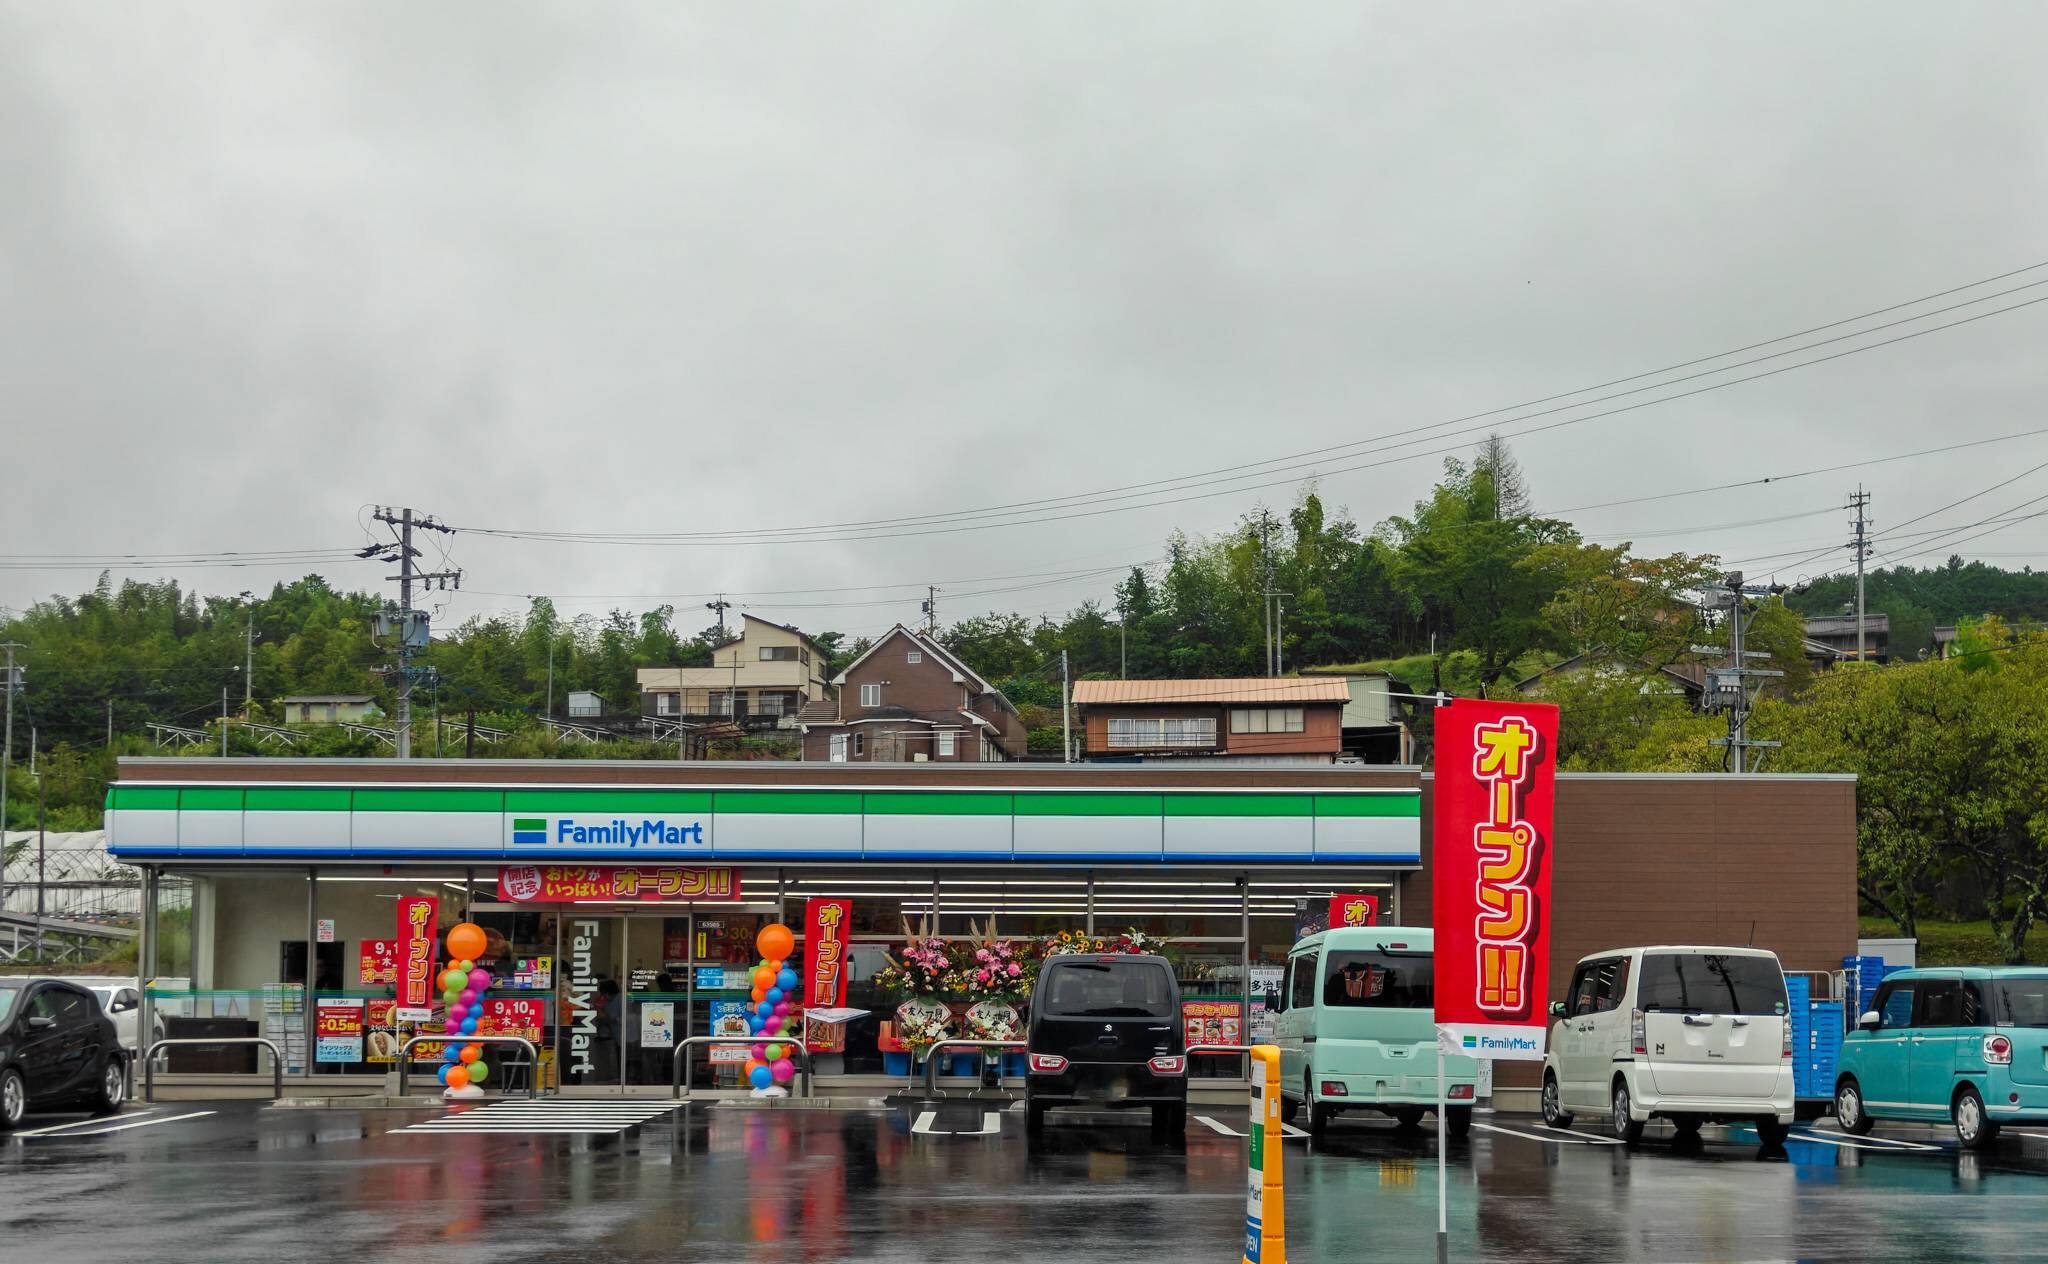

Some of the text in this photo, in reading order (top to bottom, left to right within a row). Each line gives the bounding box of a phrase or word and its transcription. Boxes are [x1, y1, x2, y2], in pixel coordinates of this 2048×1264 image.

[558, 819, 702, 847] FamilyMart
[1473, 716, 1537, 1010] オープン!!
[507, 867, 535, 881] 開店
[546, 867, 601, 882] おトクが
[613, 867, 731, 896] オープン!!
[510, 881, 539, 895] 記念
[546, 882, 610, 897] いっぱい!
[408, 901, 431, 1004] オープン!!
[568, 920, 599, 1074] FamilyMart
[1481, 1036, 1537, 1050] FamilyMart
